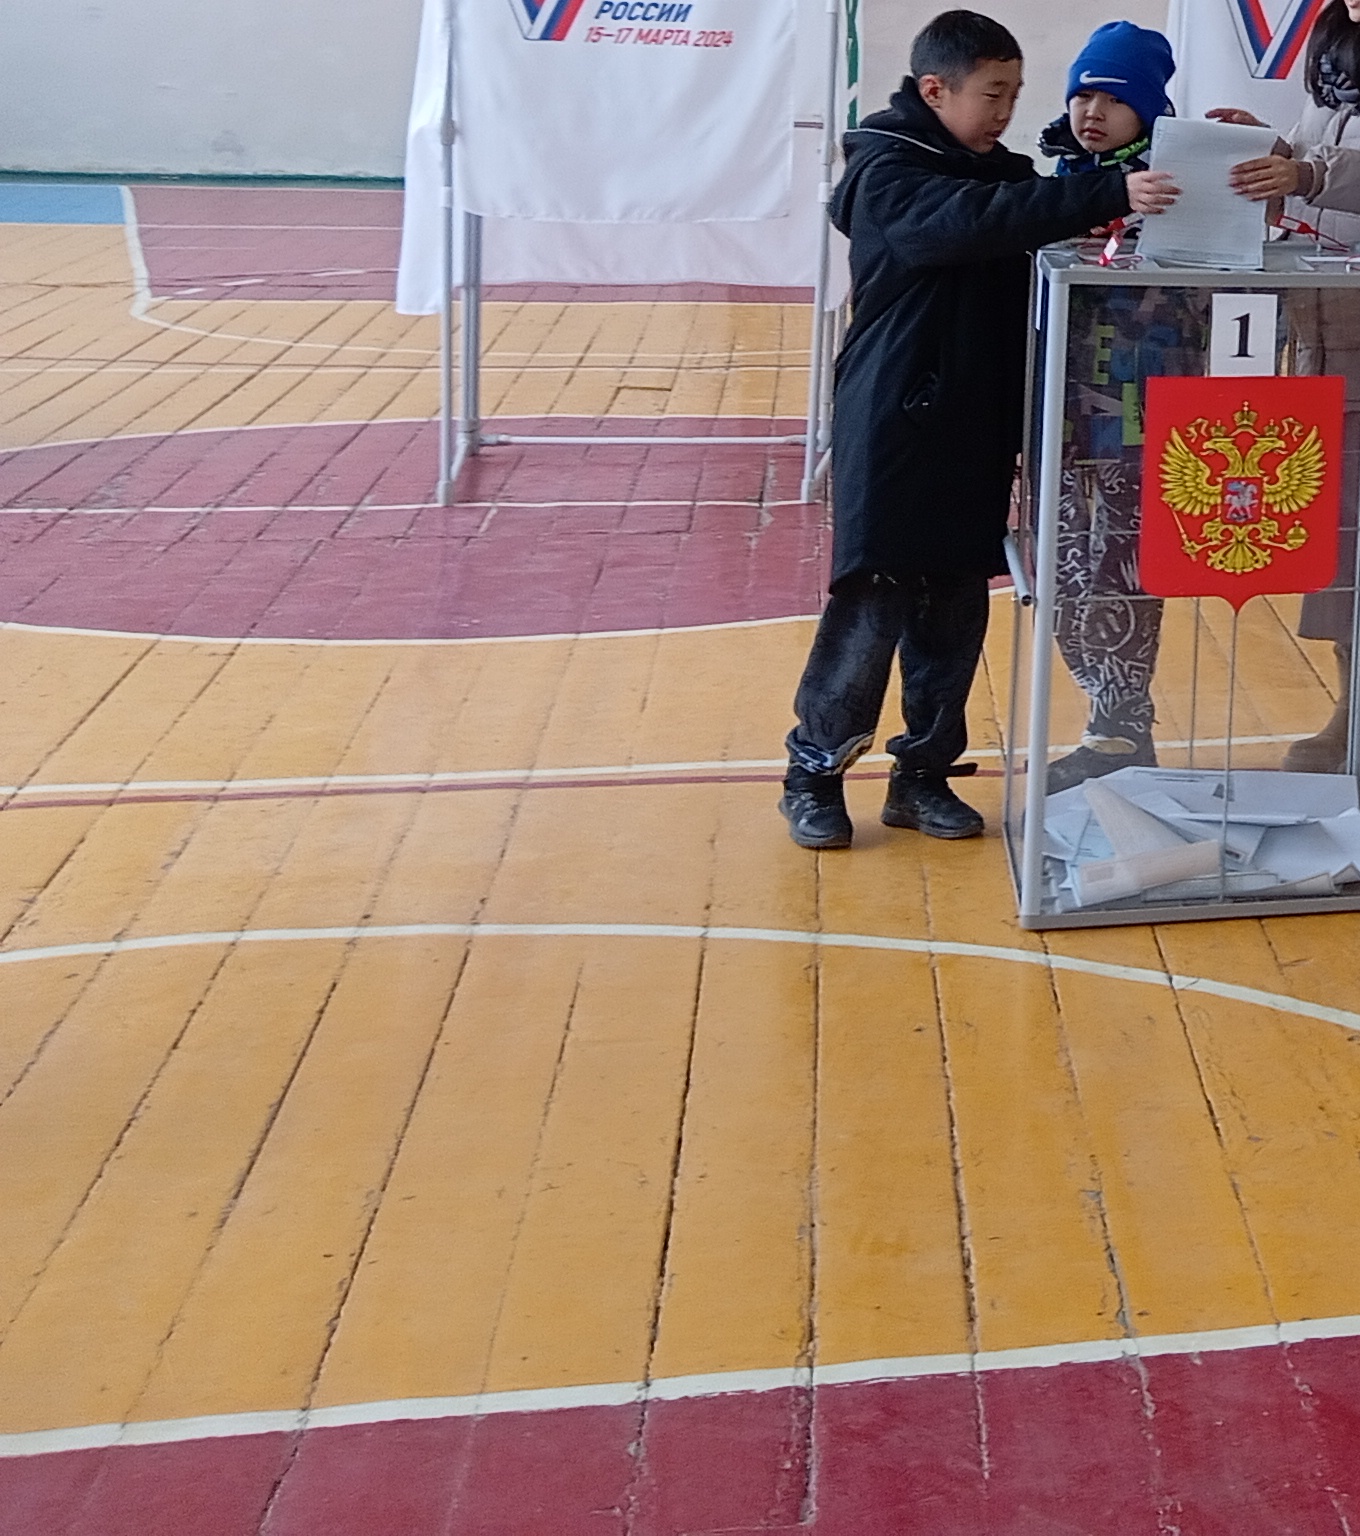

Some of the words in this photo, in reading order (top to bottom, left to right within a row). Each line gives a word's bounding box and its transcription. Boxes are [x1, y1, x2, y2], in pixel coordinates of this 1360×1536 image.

[594, 1, 693, 23] РОССИИ
[633, 28, 689, 46] МАРТА
[693, 30, 735, 48] 2024
[1230, 312, 1256, 359] 1
